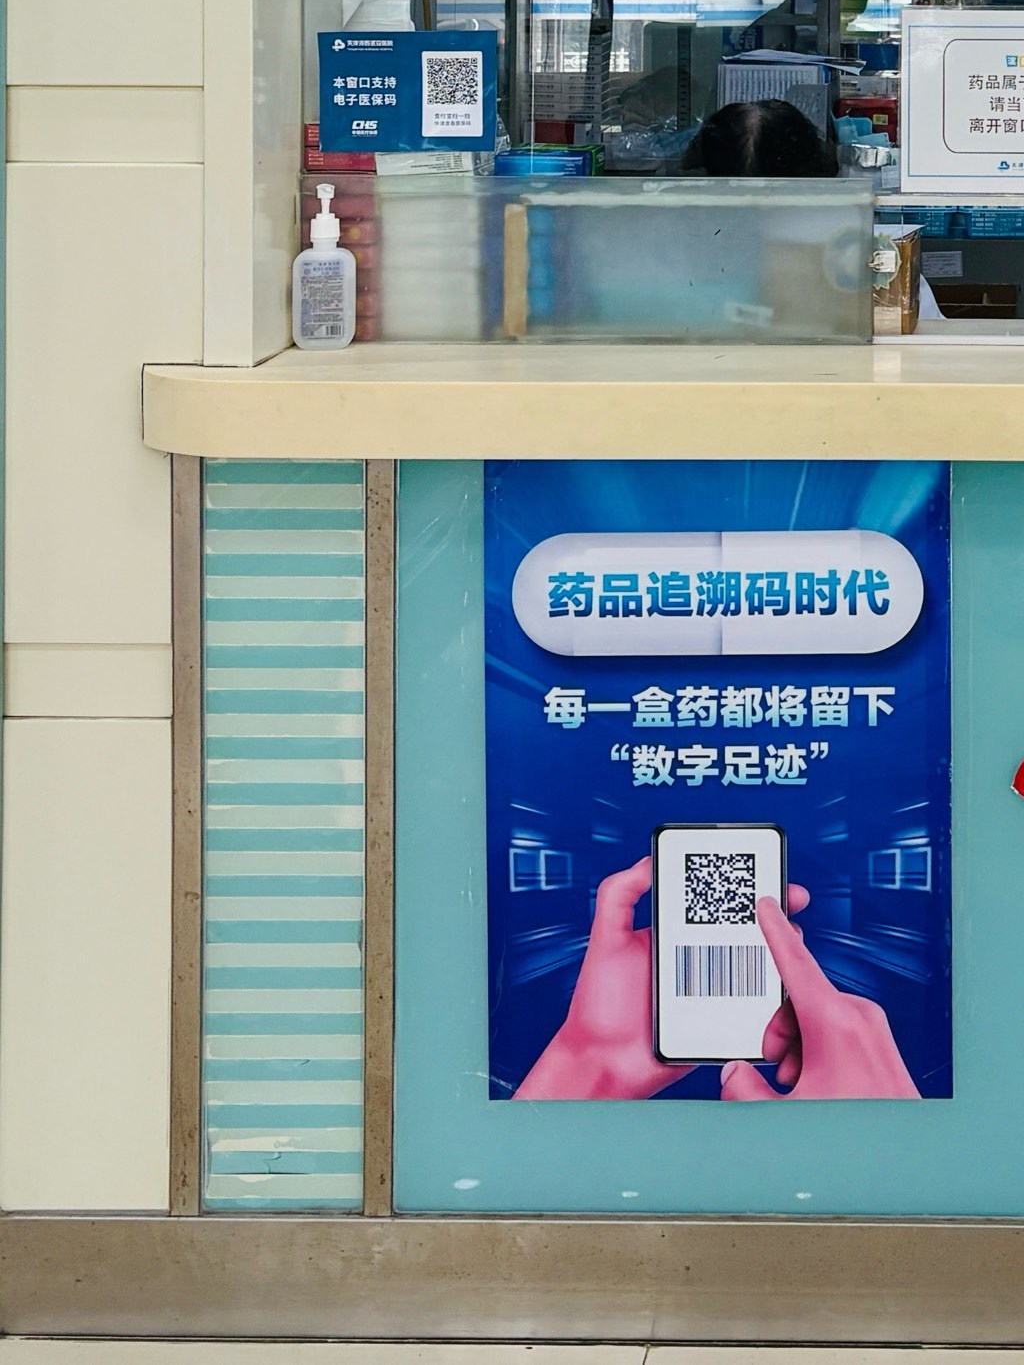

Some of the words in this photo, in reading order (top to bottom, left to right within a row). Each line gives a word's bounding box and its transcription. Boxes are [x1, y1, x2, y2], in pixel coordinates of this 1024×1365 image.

[333, 76, 397, 89] 本窗口支持
[333, 93, 397, 107] 电子医保码
[352, 120, 378, 130] CHS
[548, 569, 890, 618] 药品追溯码时代
[543, 686, 896, 729] 每一盒药都将留下
[610, 741, 830, 787] “数字足迹”
